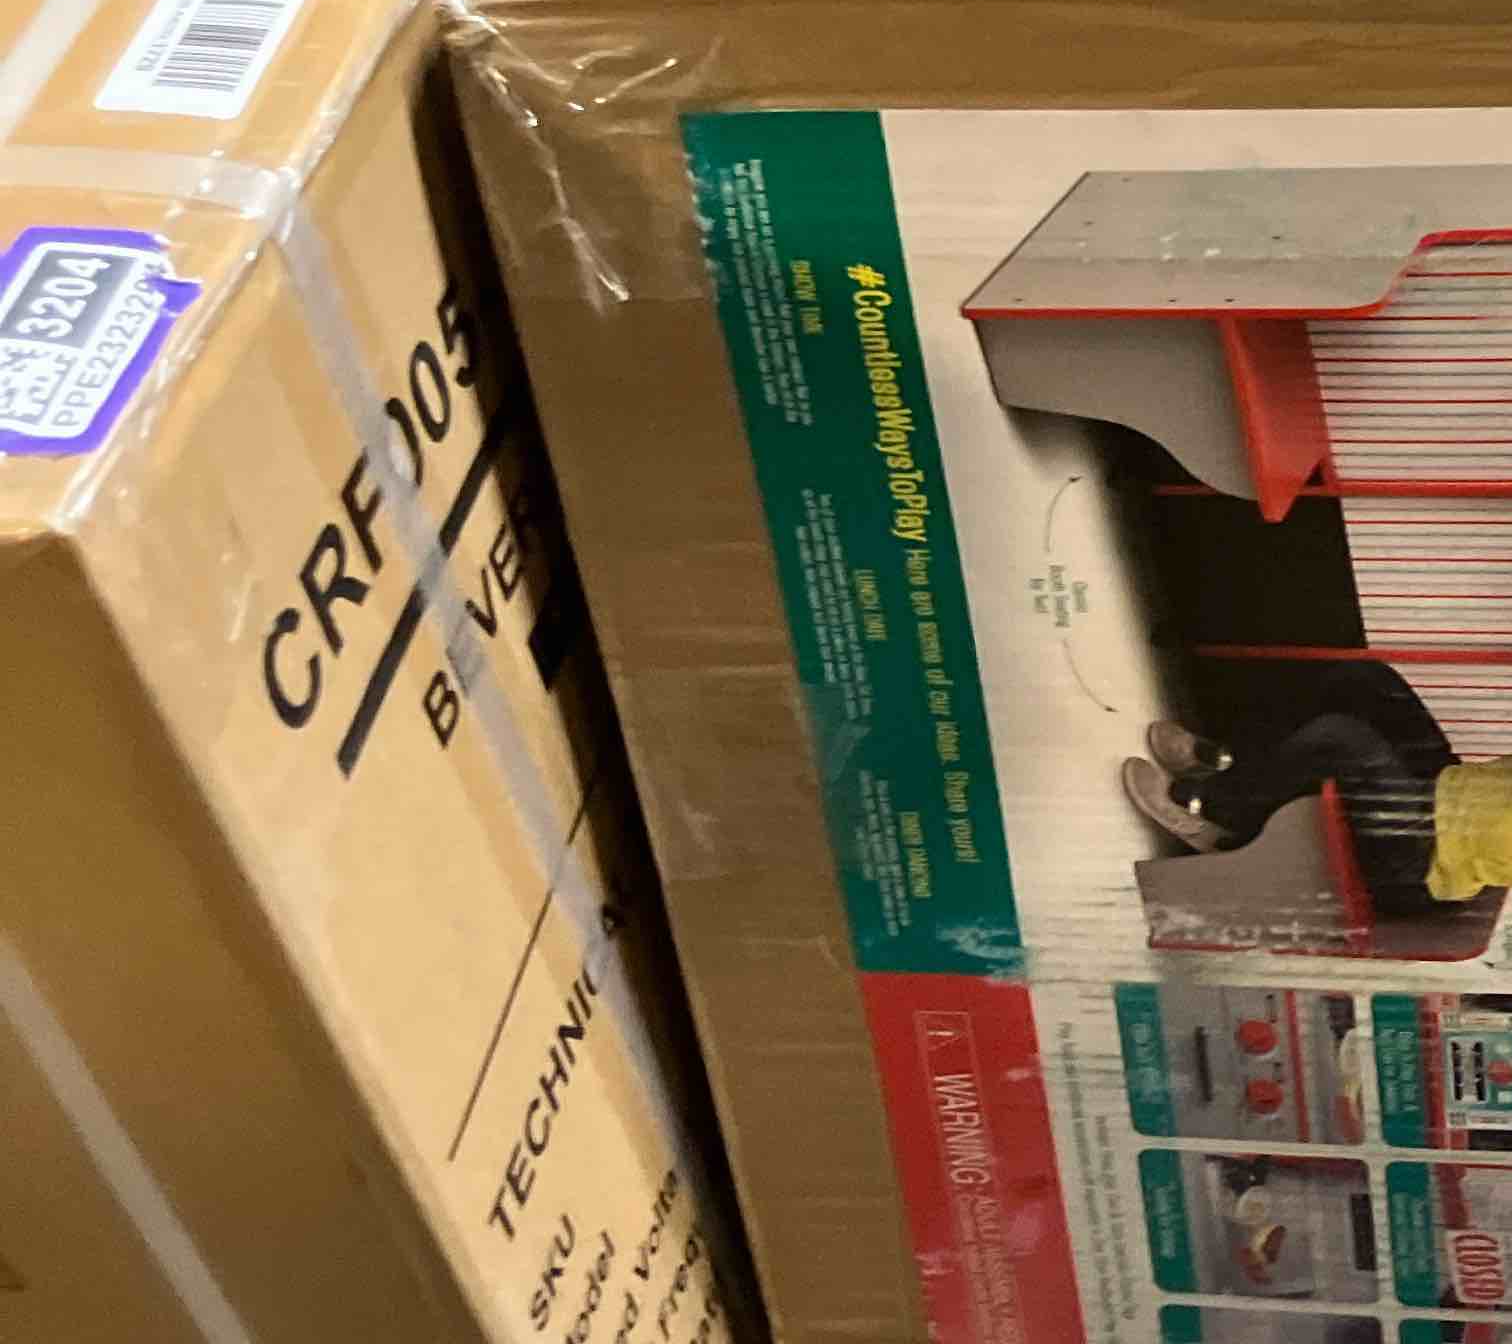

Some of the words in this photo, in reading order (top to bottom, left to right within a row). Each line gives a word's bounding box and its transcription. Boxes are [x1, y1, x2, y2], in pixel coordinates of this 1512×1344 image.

[15, 255, 114, 339] 3204
[847, 264, 930, 542] #CountlessWaysToPlay
[905, 548, 930, 584] Here
[926, 668, 953, 687] of
[927, 690, 949, 715] our
[944, 817, 981, 864] yours!
[531, 1212, 575, 1332] SKU
[1452, 1233, 1506, 1303] CLOSED
